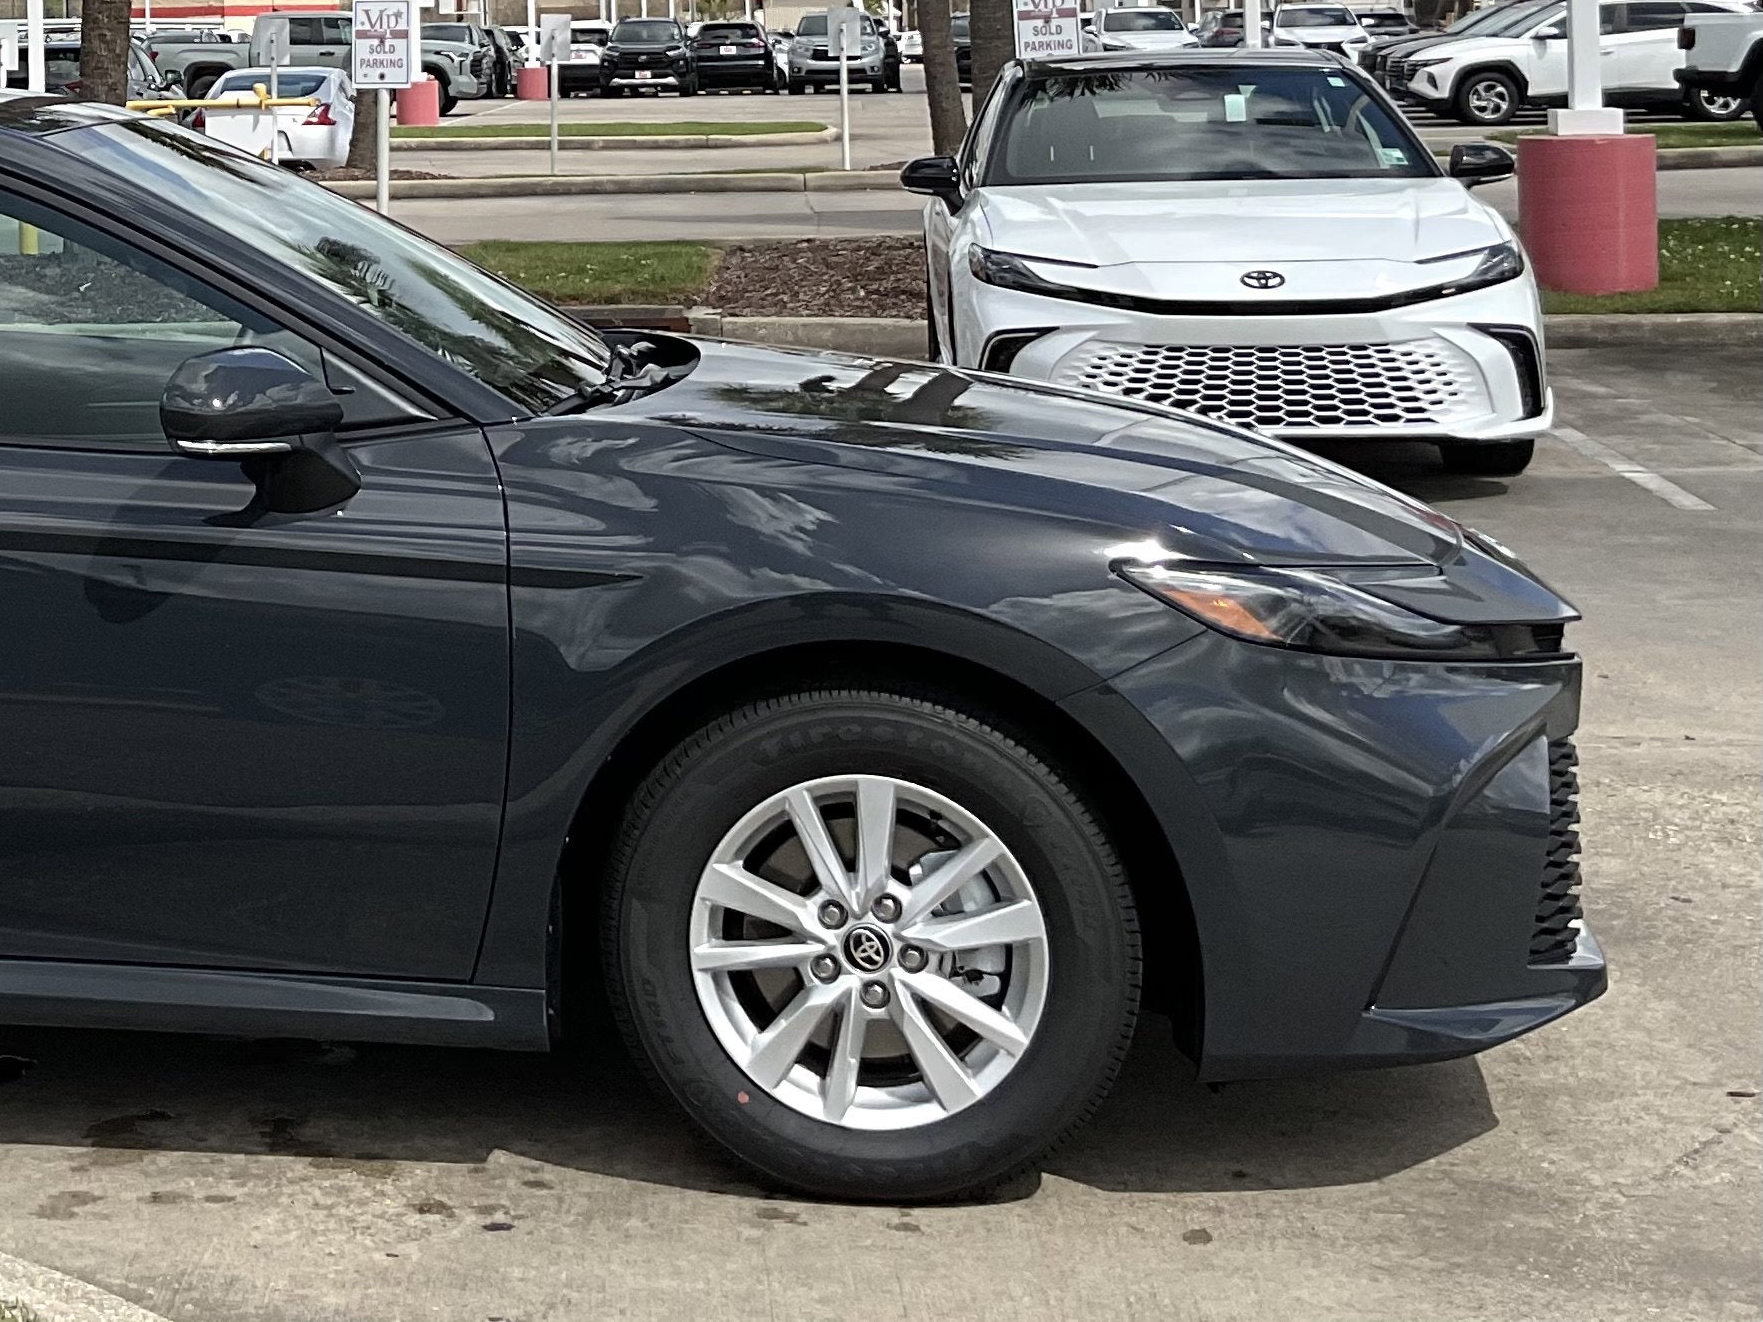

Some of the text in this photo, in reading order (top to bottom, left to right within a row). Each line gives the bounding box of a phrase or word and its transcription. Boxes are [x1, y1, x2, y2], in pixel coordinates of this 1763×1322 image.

[1032, 24, 1063, 36] SOLD
[368, 44, 396, 55] SOLD
[1023, 39, 1074, 52] PARKING
[359, 58, 404, 69] PARKING
